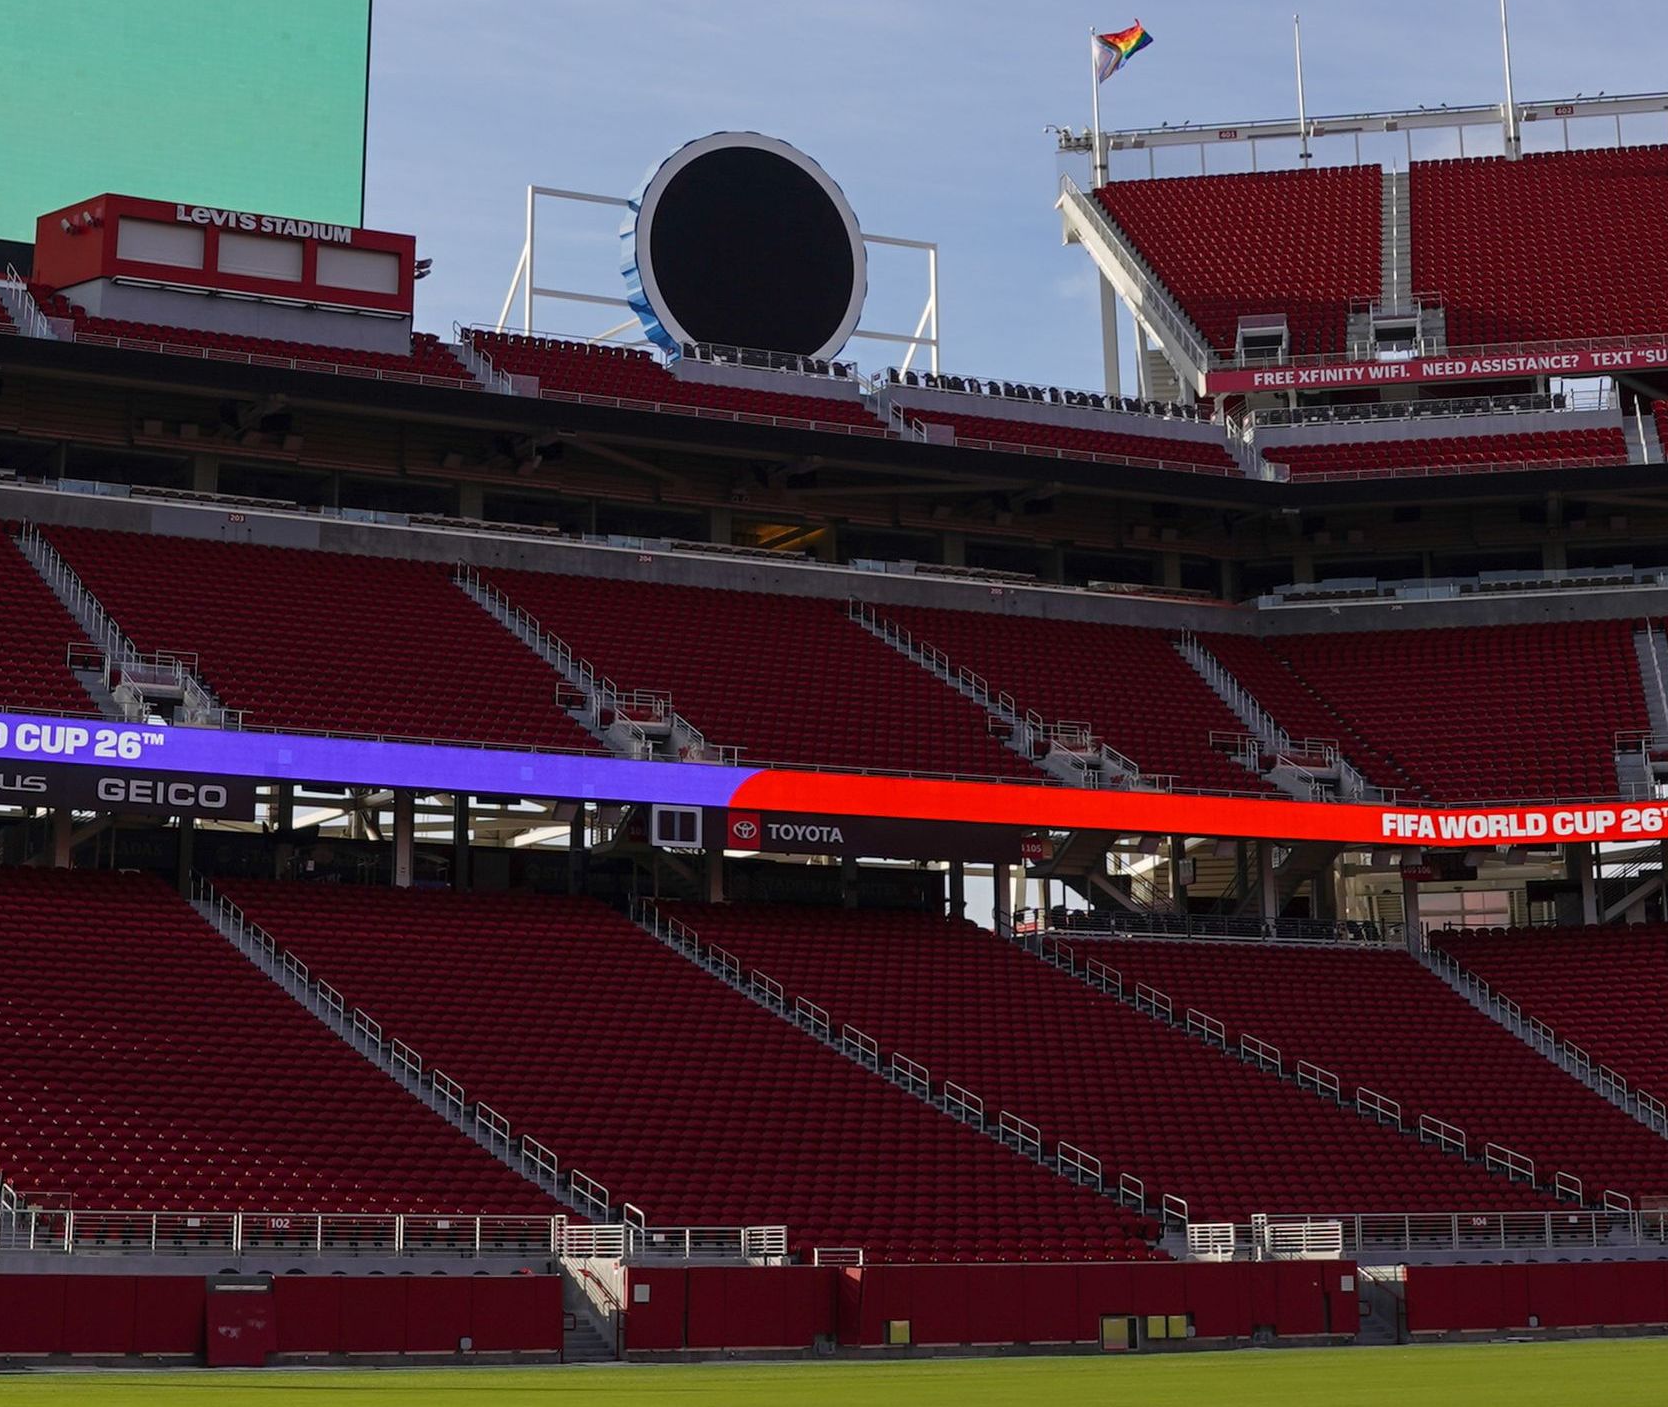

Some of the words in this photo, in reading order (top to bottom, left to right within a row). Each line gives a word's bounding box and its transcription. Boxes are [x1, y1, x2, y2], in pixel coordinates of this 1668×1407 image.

[261, 217, 351, 244] STADIUM
[1254, 372, 1295, 386] FREE
[1298, 367, 1364, 383] XFINITY
[1365, 364, 1411, 379] WIFI.
[1422, 360, 1467, 376] NEED
[1470, 355, 1579, 373] ASSISTANCE?
[1591, 351, 1633, 367] TEXT
[15, 724, 90, 755] CUP
[97, 777, 228, 809] GEICO
[767, 822, 844, 845] TOYOTA
[1382, 812, 1436, 839] FIFA
[1438, 812, 1547, 839] WORLD
[1552, 810, 1616, 835] CUP
[270, 1218, 290, 1228] 102
